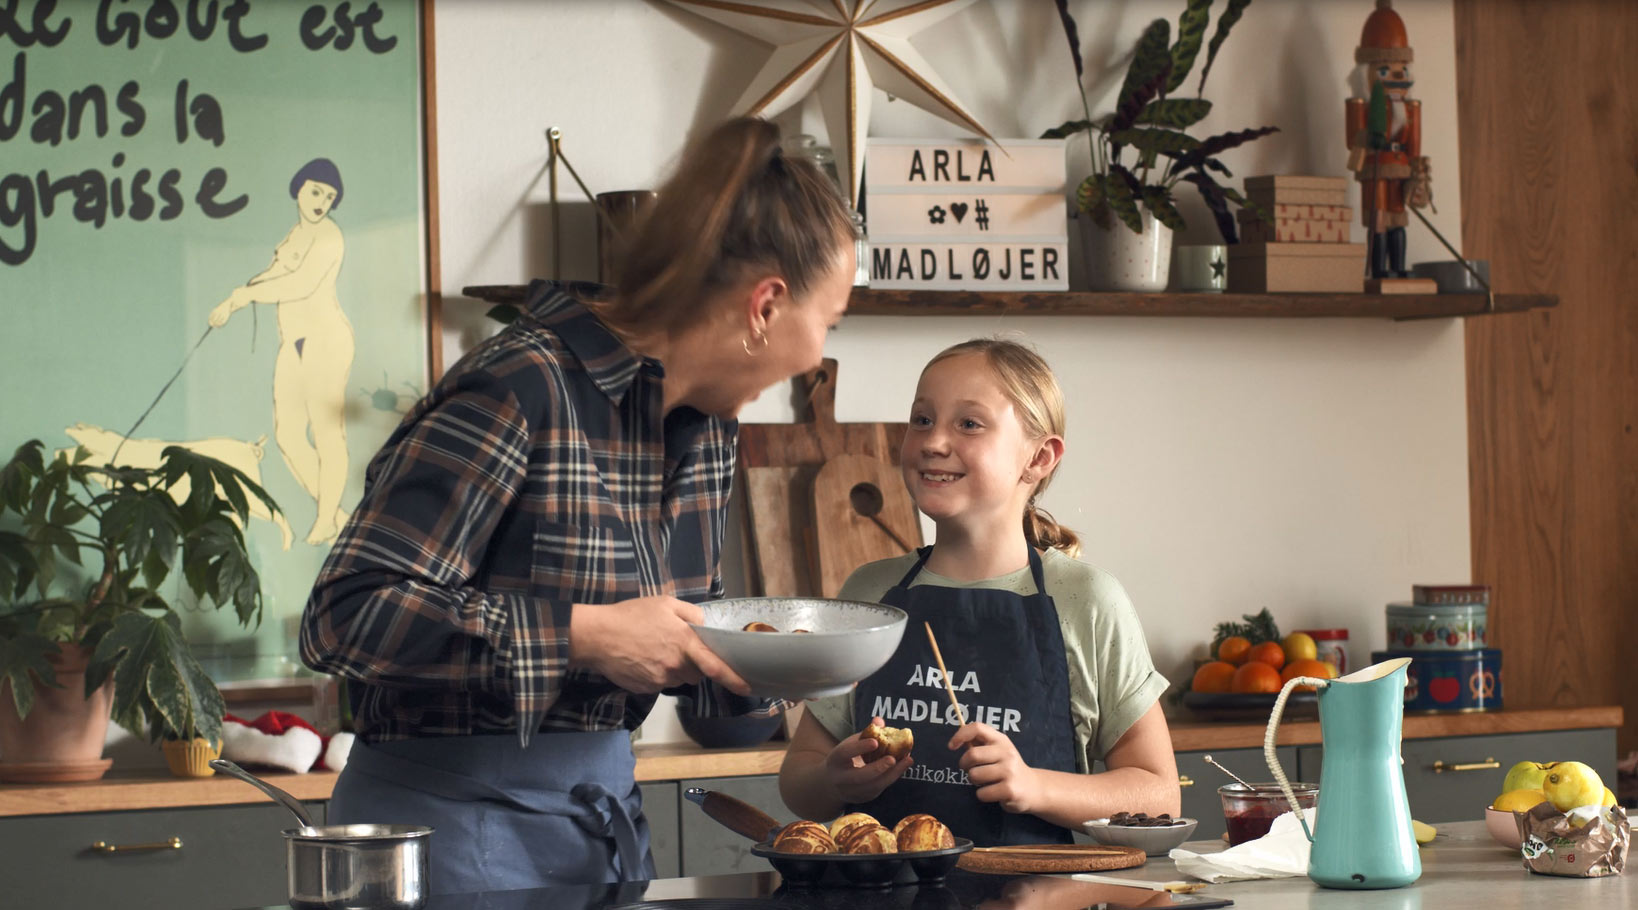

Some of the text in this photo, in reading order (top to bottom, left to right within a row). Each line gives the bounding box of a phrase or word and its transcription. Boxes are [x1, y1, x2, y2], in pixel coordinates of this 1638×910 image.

[300, 2, 398, 54] est
[0, 51, 225, 147] dans la
[908, 149, 995, 182] ARLA
[0, 152, 249, 266] graisse
[872, 247, 1060, 281] MADLØJER
[906, 664, 981, 693] ARLA
[871, 695, 1022, 733] MADLØJER
[902, 764, 973, 786] nikøkk
